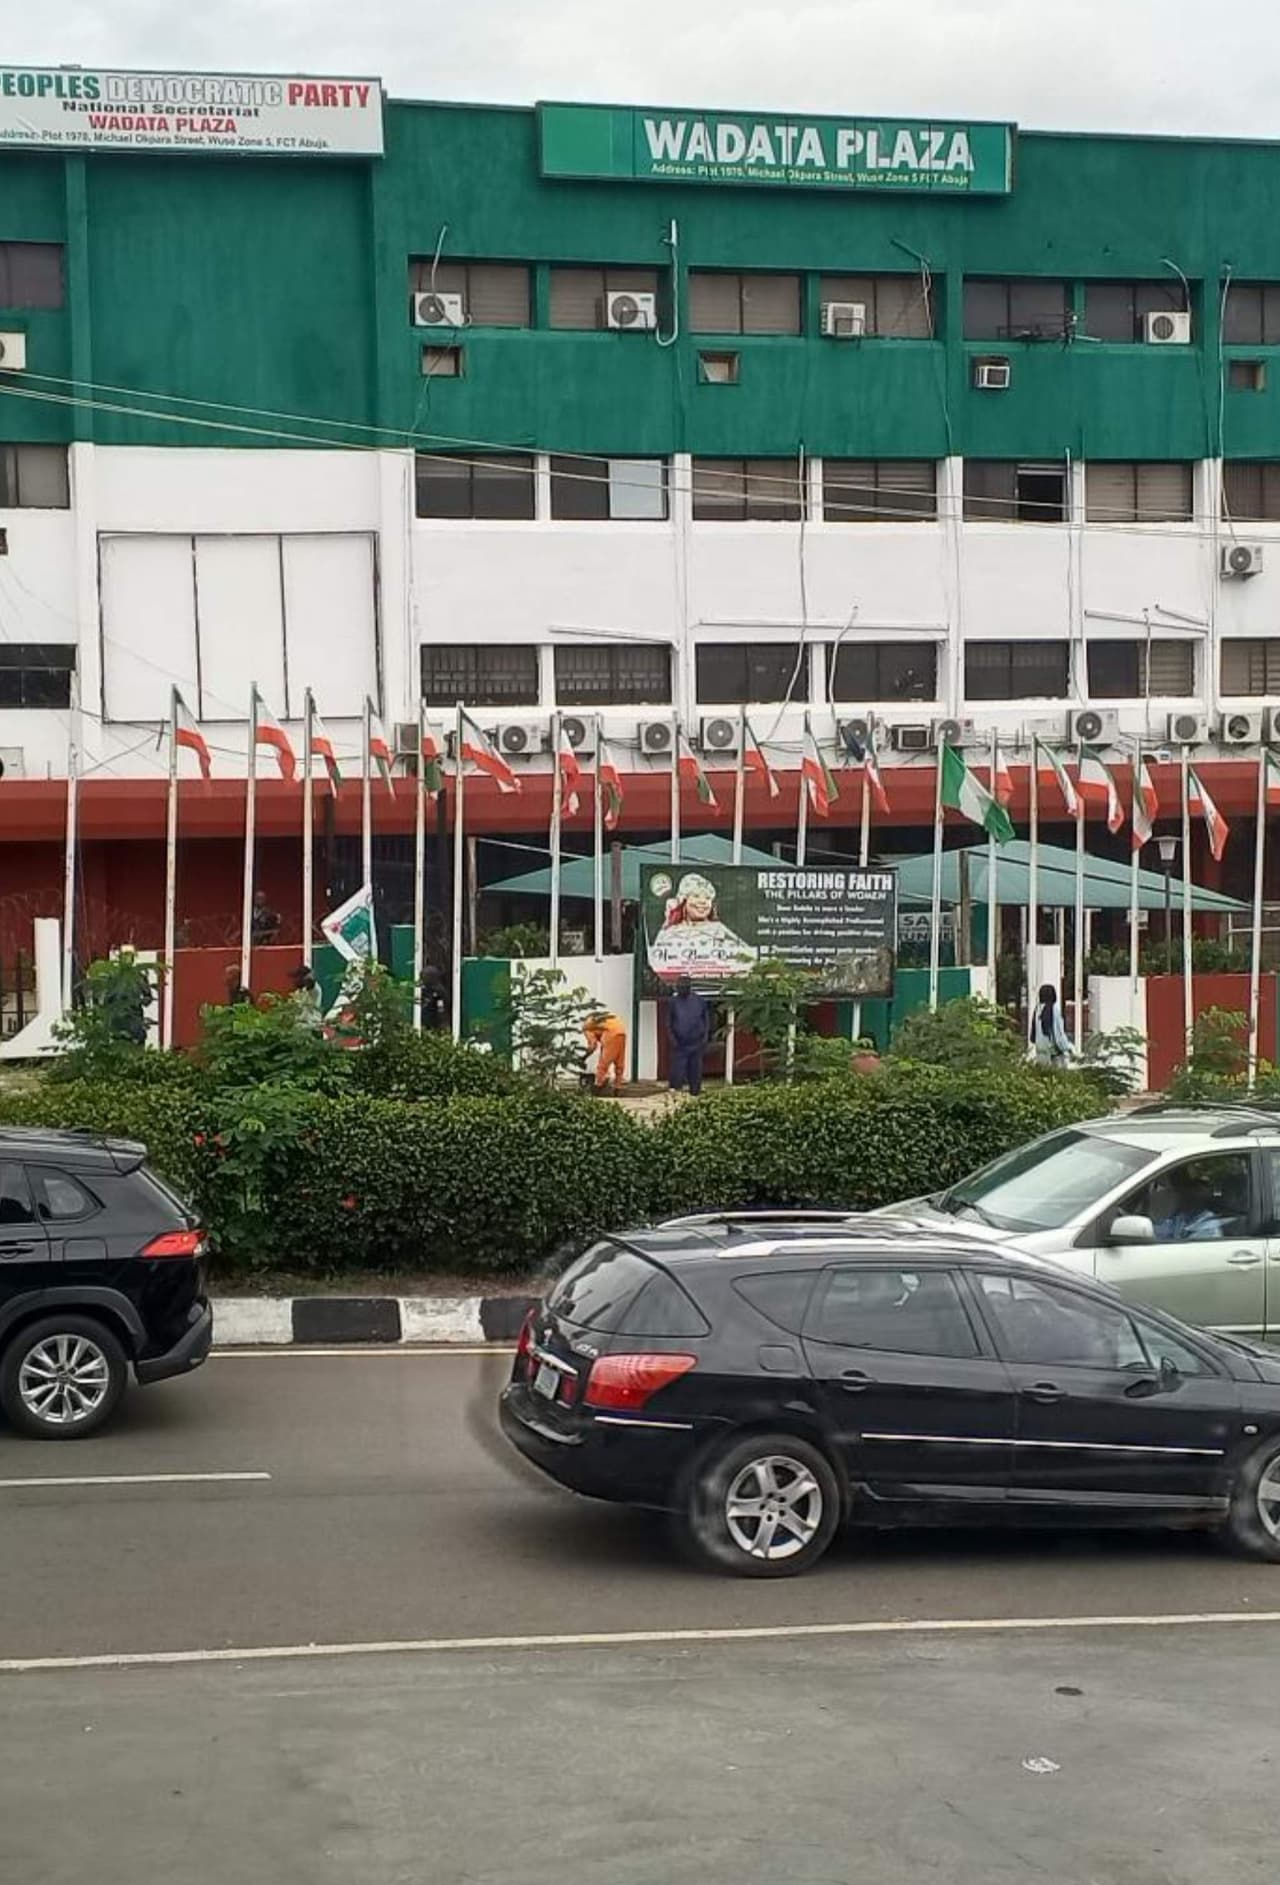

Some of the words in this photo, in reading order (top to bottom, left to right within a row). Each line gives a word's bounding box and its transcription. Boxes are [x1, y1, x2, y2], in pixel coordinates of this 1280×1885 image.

[106, 75, 283, 106] DEMOCRATIC
[288, 82, 370, 107] PARTY
[62, 101, 145, 114] National
[152, 103, 260, 118] Secretariat
[89, 115, 169, 132] WADATA
[176, 118, 238, 133] PLAZA
[94, 132, 132, 143] Michael
[135, 133, 171, 145] Okpara
[208, 136, 235, 145] Wuse
[238, 137, 263, 147] Zone
[276, 138, 296, 148] FCT
[644, 119, 825, 167] WADATA
[837, 129, 974, 171] PLAZA
[748, 167, 785, 178] Michael
[885, 172, 909, 183] Zone
[757, 872, 845, 889] RESTORING
[849, 874, 893, 890] FAITH
[764, 890, 785, 899] THE
[787, 890, 828, 900] PILLARS
[831, 890, 843, 900] OF
[847, 891, 887, 900] WOMEN
